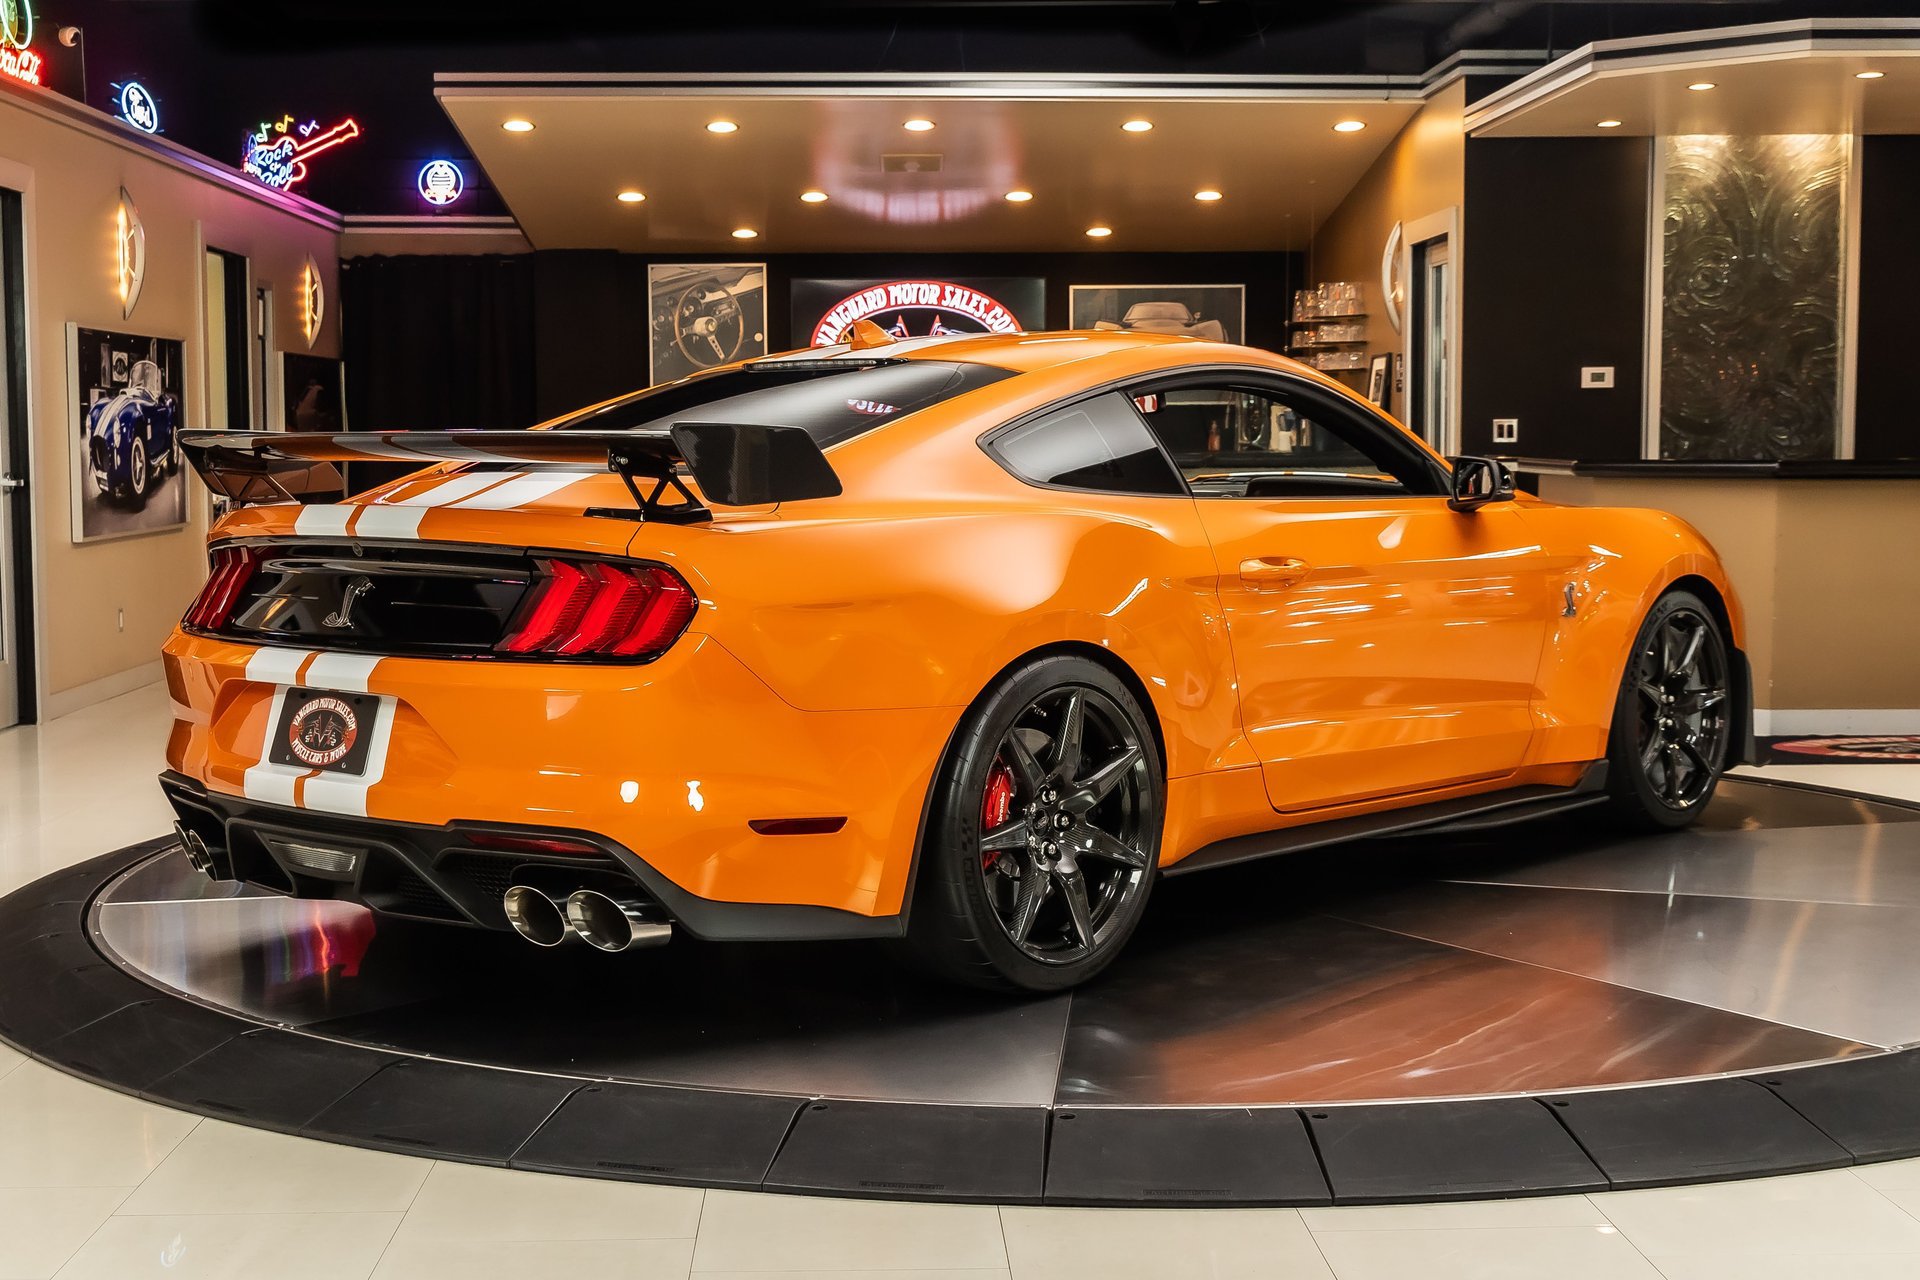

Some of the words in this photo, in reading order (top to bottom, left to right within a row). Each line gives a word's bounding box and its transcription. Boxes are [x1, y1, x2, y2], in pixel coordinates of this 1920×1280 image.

[257, 140, 293, 167] Rock
[815, 287, 887, 346] VANGUARD
[887, 283, 941, 306] MOTOR
[292, 699, 320, 727] VANGUARD
[319, 698, 336, 709] MOTOR
[335, 700, 356, 731] SALES.COM
[292, 737, 310, 761] MUSCLE
[309, 751, 323, 764] CARS
[329, 743, 347, 761] MORE
[997, 791, 1006, 822] brembo
